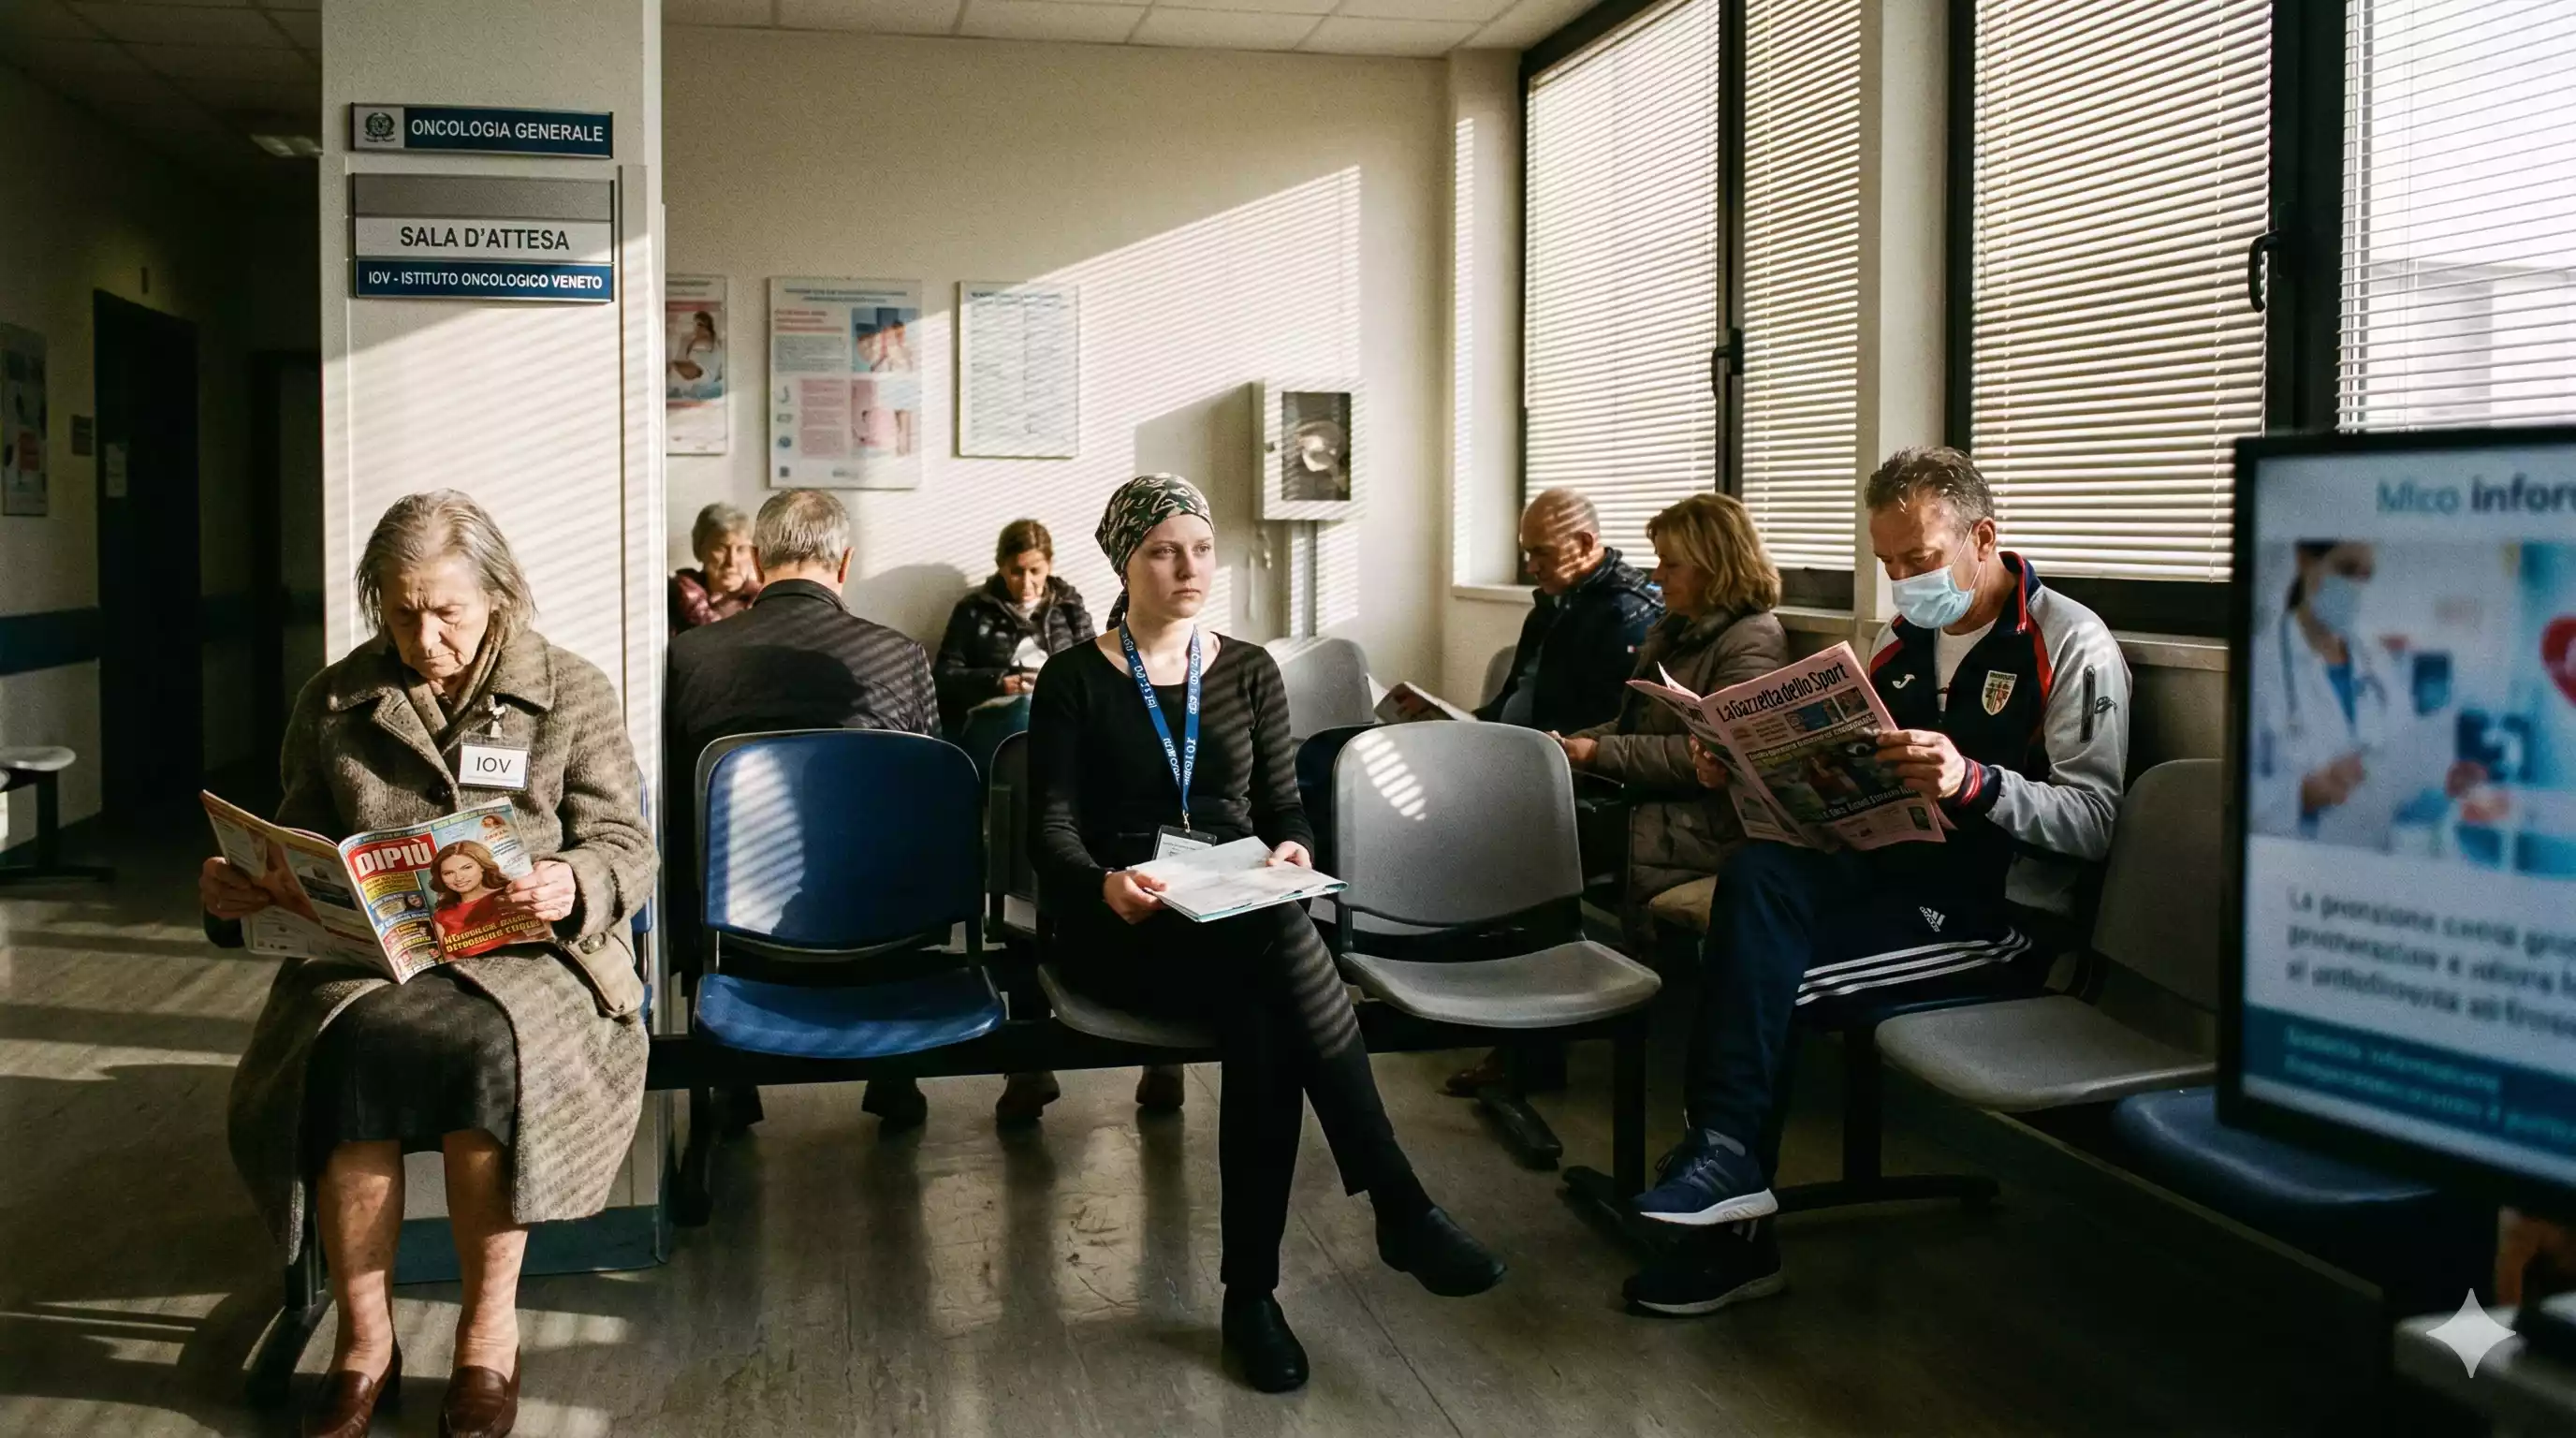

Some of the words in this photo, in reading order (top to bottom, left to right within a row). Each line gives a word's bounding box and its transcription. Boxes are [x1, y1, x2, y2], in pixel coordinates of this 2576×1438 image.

[412, 120, 510, 139] ONCOLOGIA
[515, 123, 604, 141] GENERALE
[401, 227, 458, 246] SALA
[464, 227, 569, 250] D'ATTESA
[369, 271, 390, 285] IOV
[402, 271, 458, 286] ISTITUTO
[461, 272, 549, 287] ONCOLOGICO
[551, 275, 602, 289] VENETO
[2471, 472, 2576, 512] infor
[1808, 662, 1850, 693] Sport
[476, 756, 511, 773] IOV
[355, 838, 432, 877] DIPIÙ
